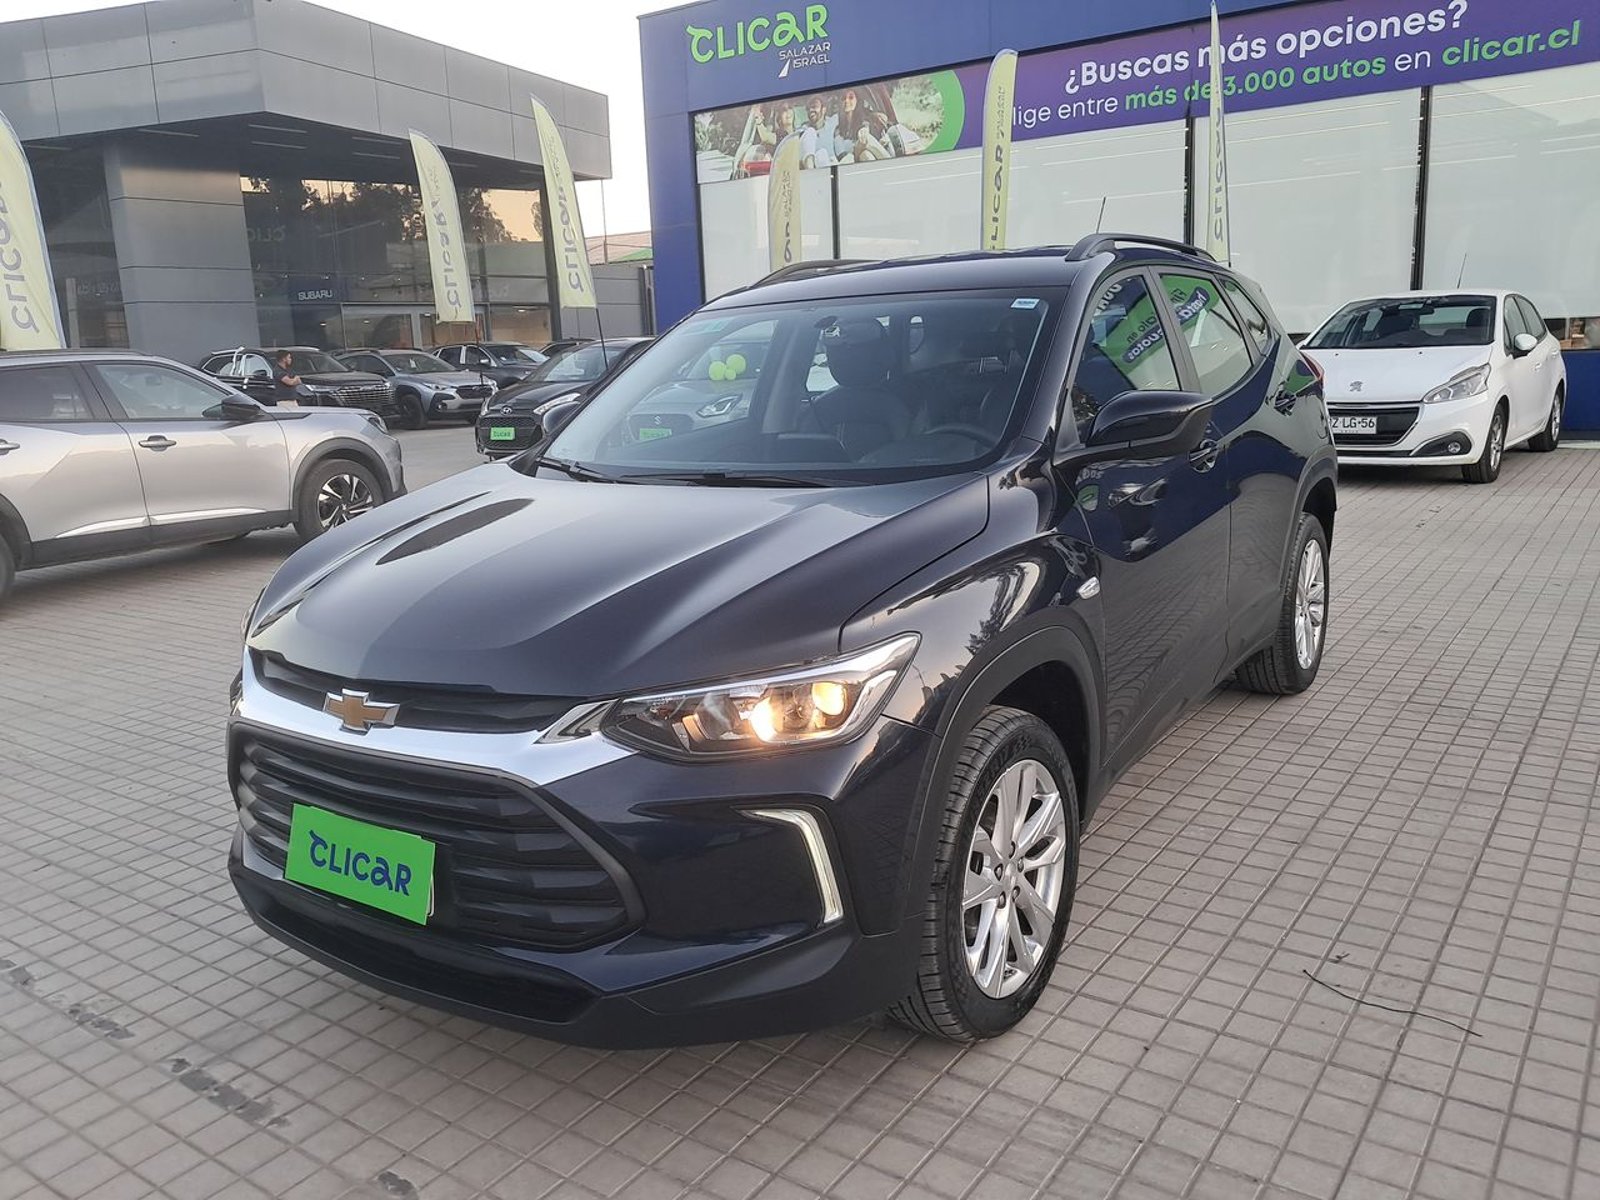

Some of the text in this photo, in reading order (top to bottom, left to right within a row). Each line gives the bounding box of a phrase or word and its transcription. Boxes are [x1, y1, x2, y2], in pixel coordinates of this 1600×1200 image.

[779, 42, 830, 60] SALAZAR
[1065, 50, 1189, 94] ¿Buscas
[1276, 0, 1468, 58] opciones?
[793, 54, 830, 69] ISRAEL
[1013, 105, 1050, 128] lige
[1058, 97, 1118, 119] entre
[1125, 85, 1177, 110] más
[1184, 80, 1211, 100] de
[1223, 66, 1295, 96] 3.000
[1302, 57, 1386, 85] autos
[1394, 50, 1431, 71] en
[1442, 19, 1581, 66] clicar.cl
[298, 289, 333, 300] SUBARU
